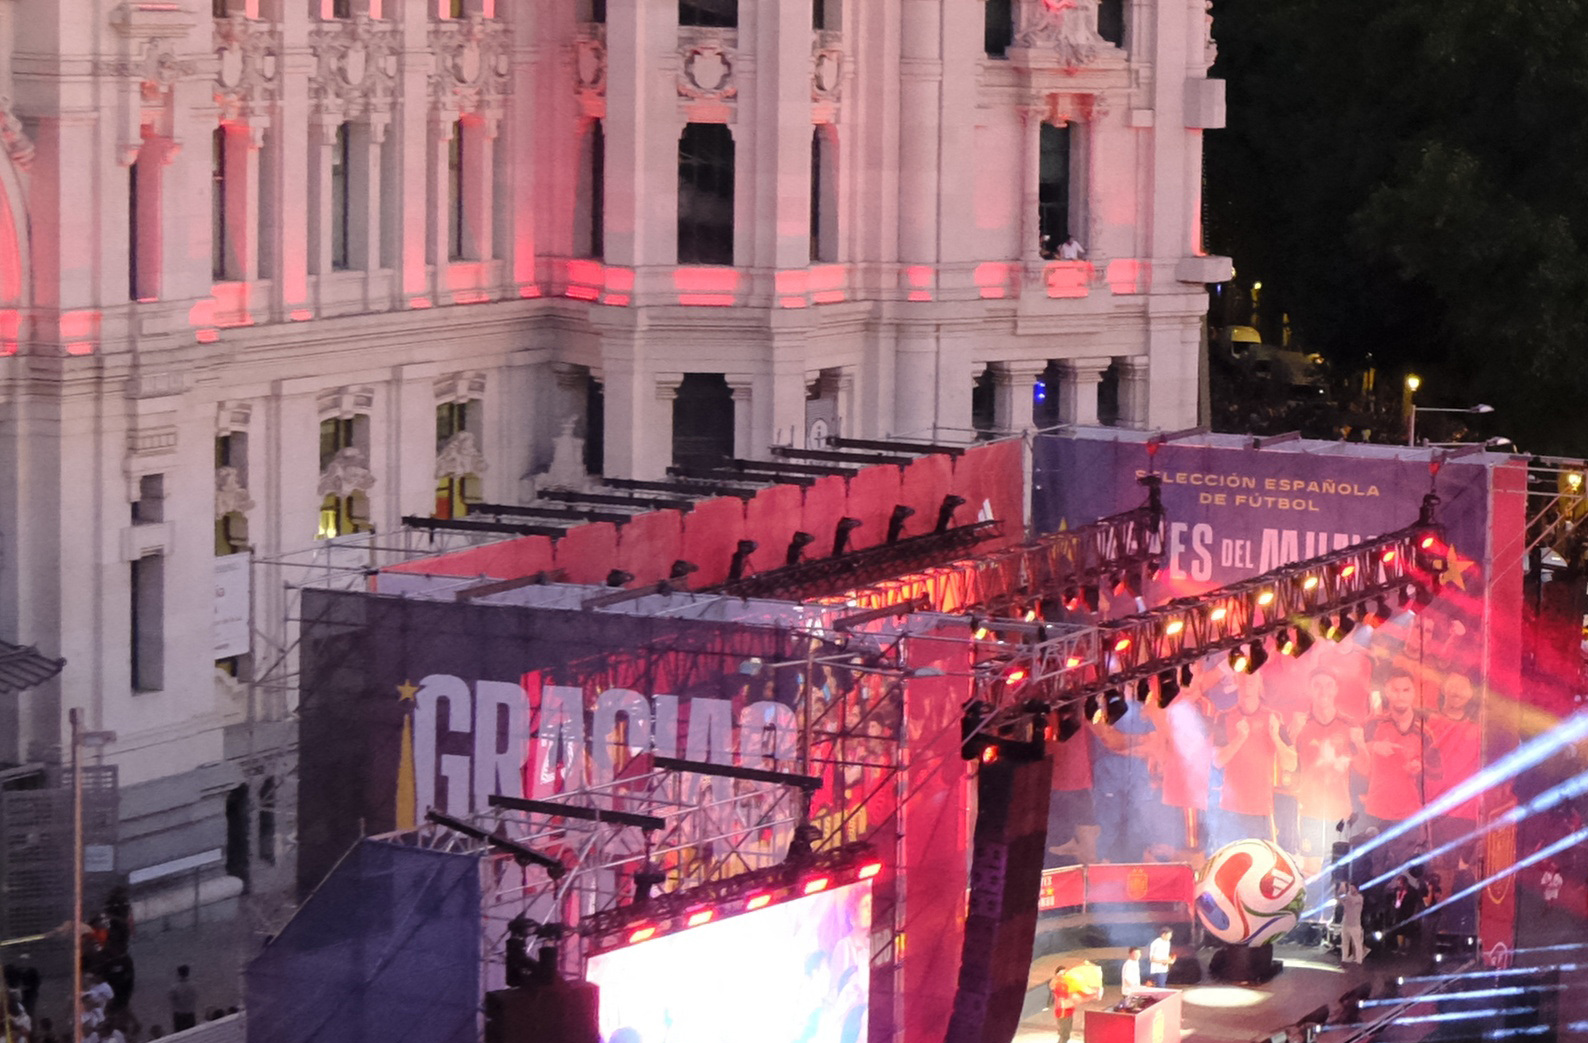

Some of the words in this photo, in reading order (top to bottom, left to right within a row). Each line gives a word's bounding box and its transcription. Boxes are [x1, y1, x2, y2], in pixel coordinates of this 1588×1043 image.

[1135, 469, 1256, 489] SLECCIÓN
[1264, 477, 1381, 497] ESPAÑOLA
[1199, 492, 1227, 505] DE
[1235, 492, 1320, 512] FÚTBOL
[1221, 538, 1255, 569] DEL
